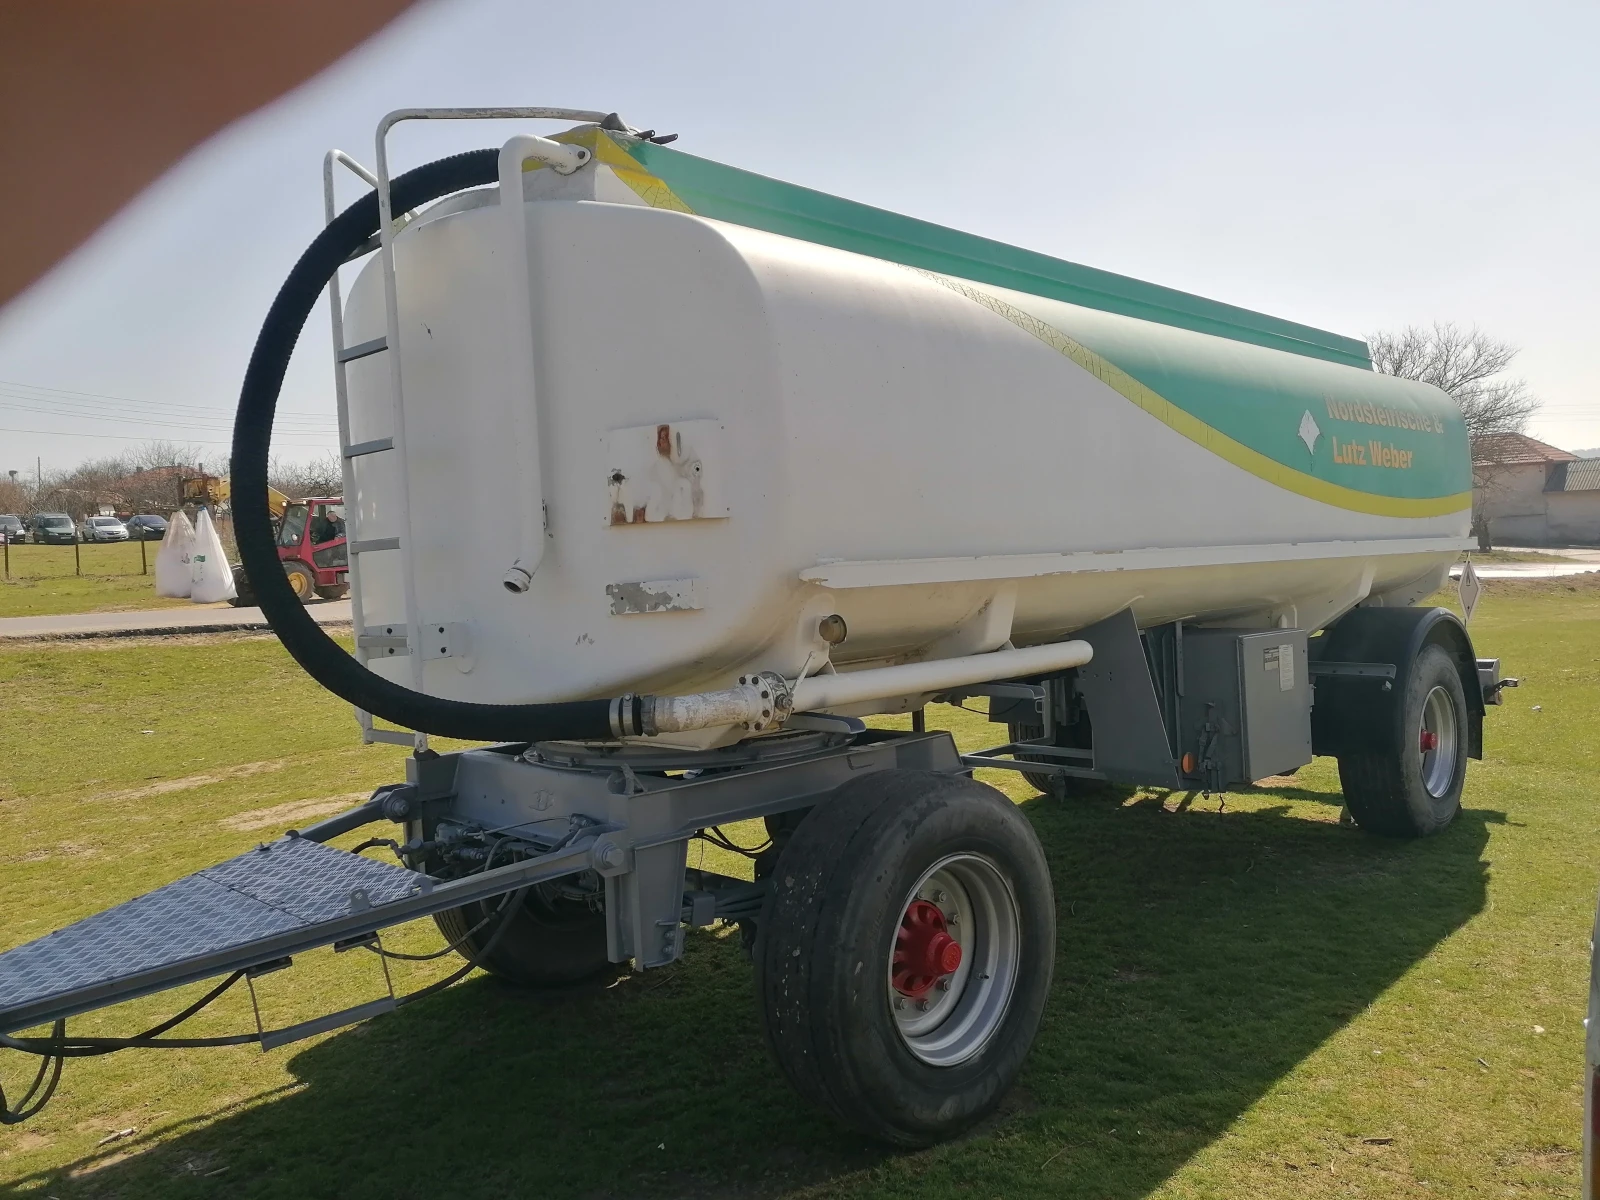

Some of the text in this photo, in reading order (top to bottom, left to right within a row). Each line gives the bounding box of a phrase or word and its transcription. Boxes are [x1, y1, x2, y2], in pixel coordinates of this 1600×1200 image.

[1433, 412, 1444, 434] &
[1332, 436, 1412, 468] Lutz Weber
